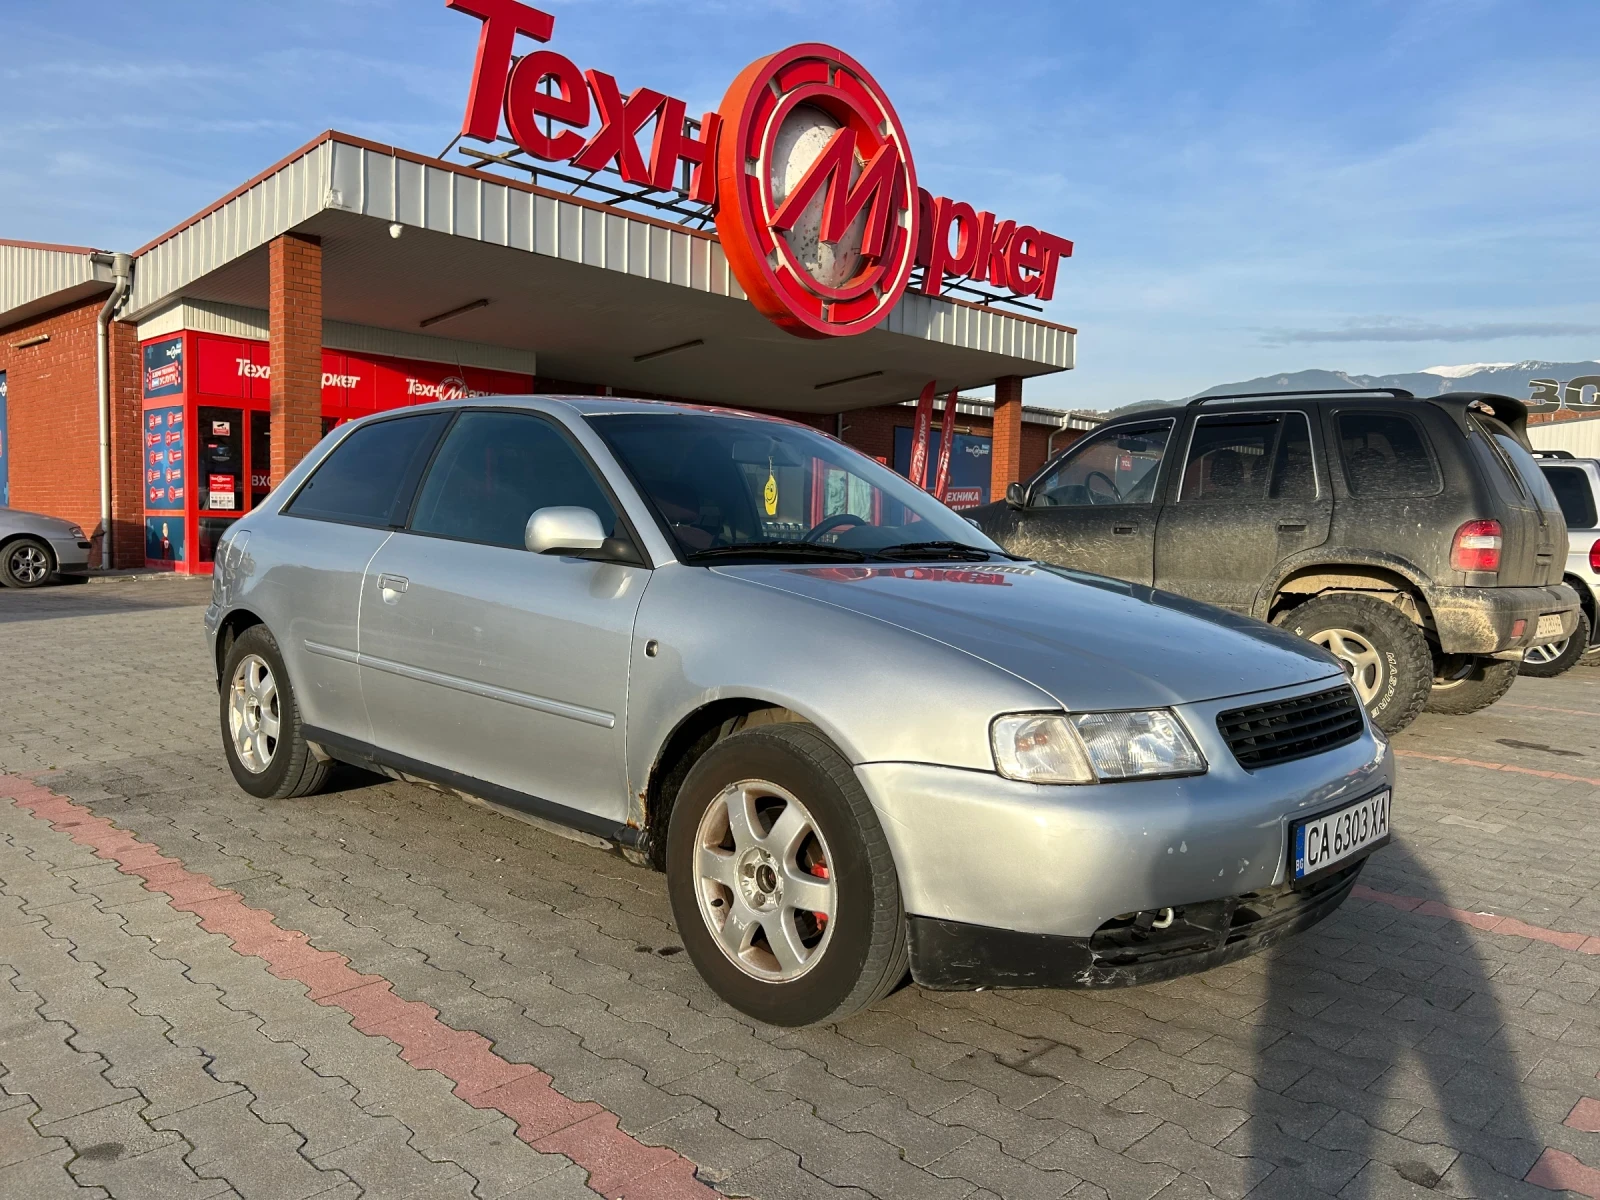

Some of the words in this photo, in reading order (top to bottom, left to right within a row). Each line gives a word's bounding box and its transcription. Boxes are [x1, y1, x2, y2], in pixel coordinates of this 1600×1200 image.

[946, 491, 979, 502] ЕХНИКА
[1307, 822, 1330, 866] CA
[1333, 806, 1368, 855] 6303
[1369, 797, 1386, 837] XA
